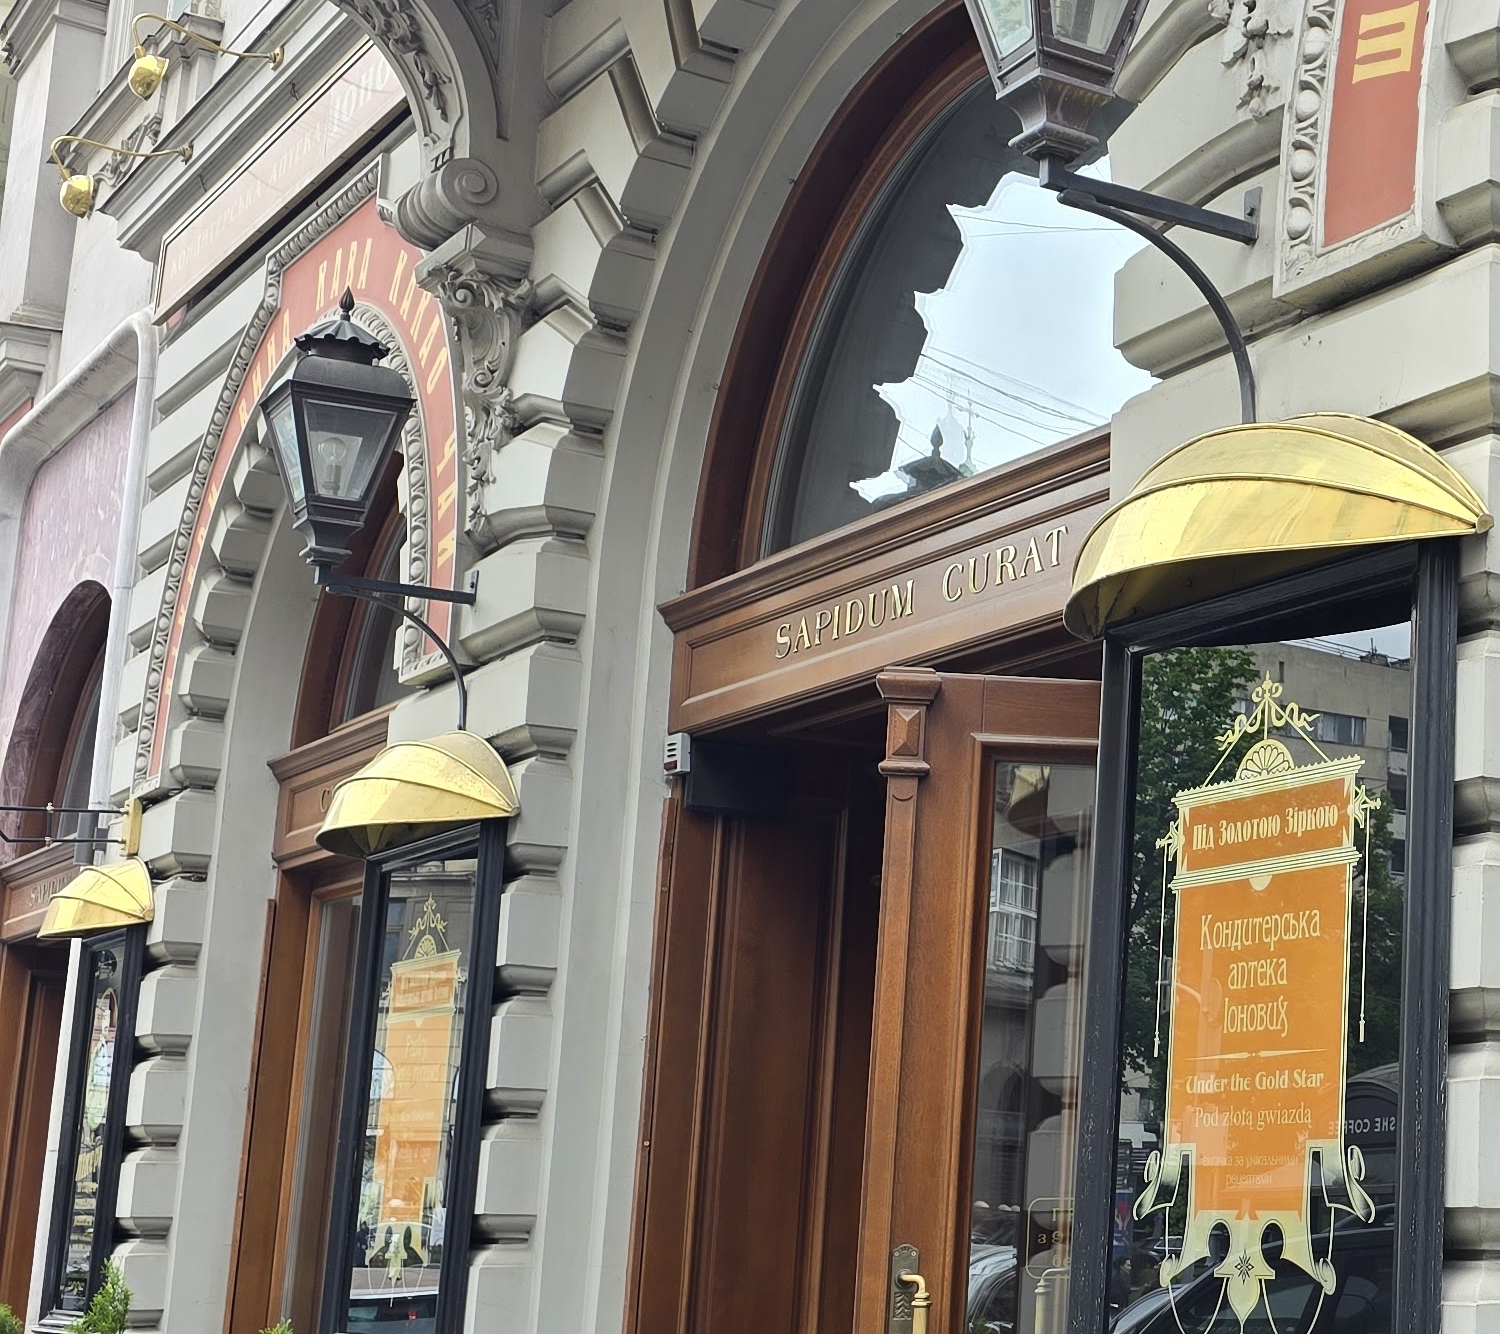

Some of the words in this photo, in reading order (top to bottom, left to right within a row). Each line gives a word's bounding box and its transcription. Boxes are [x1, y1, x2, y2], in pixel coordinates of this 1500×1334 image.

[774, 579, 915, 660] SAPIDUM
[942, 525, 1069, 603] CURAT
[1192, 824, 1214, 851] Під
[1218, 814, 1281, 846] Золотою
[1284, 804, 1339, 838] Зіркою
[1199, 908, 1321, 952] Кондитерська
[1227, 956, 1288, 990] аптека
[1223, 995, 1289, 1038] Іонових
[1185, 1074, 1228, 1094] Under
[1230, 1072, 1251, 1091] the
[1254, 1069, 1289, 1090] Gold
[1292, 1068, 1325, 1088] Star
[1195, 1107, 1219, 1128] Pod
[1222, 1105, 1253, 1130] złotą
[1257, 1101, 1312, 1131] gwiazdą
